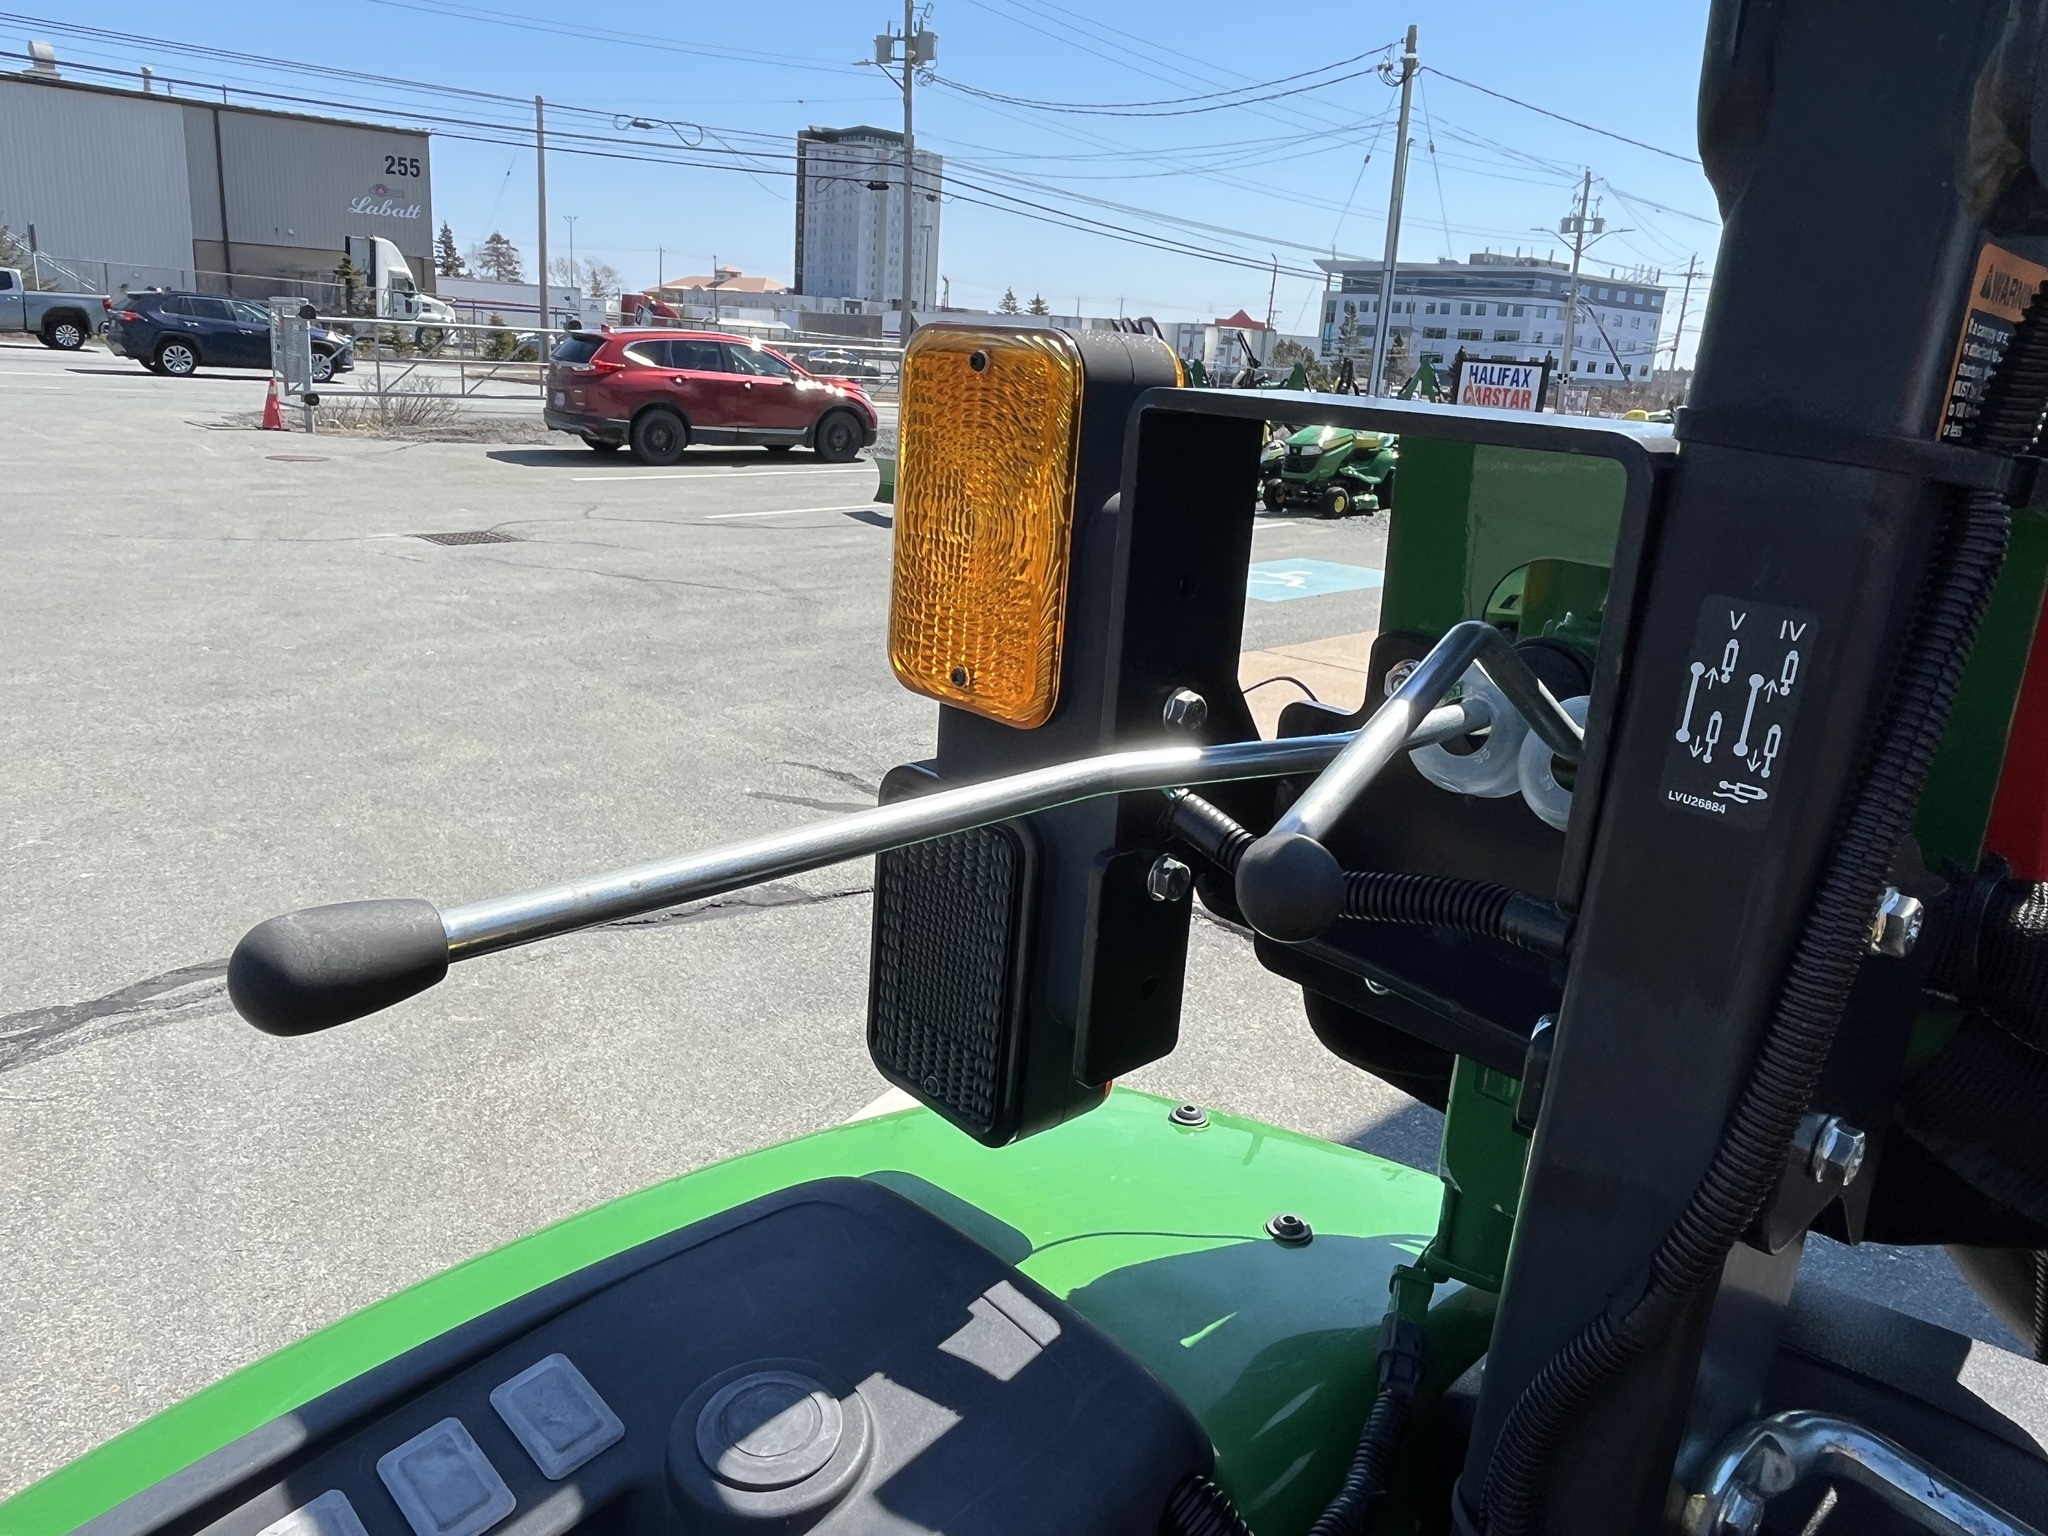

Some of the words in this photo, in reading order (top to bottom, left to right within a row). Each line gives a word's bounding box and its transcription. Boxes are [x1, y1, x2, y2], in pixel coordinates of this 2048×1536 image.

[385, 155, 421, 178] 255
[347, 196, 421, 219] Labatt
[1469, 364, 1532, 388] HALIFAX
[1462, 384, 1532, 410] CARSTAR
[1730, 610, 1746, 631] V
[1779, 619, 1806, 642] IV
[1667, 789, 1727, 814] LVU26884
